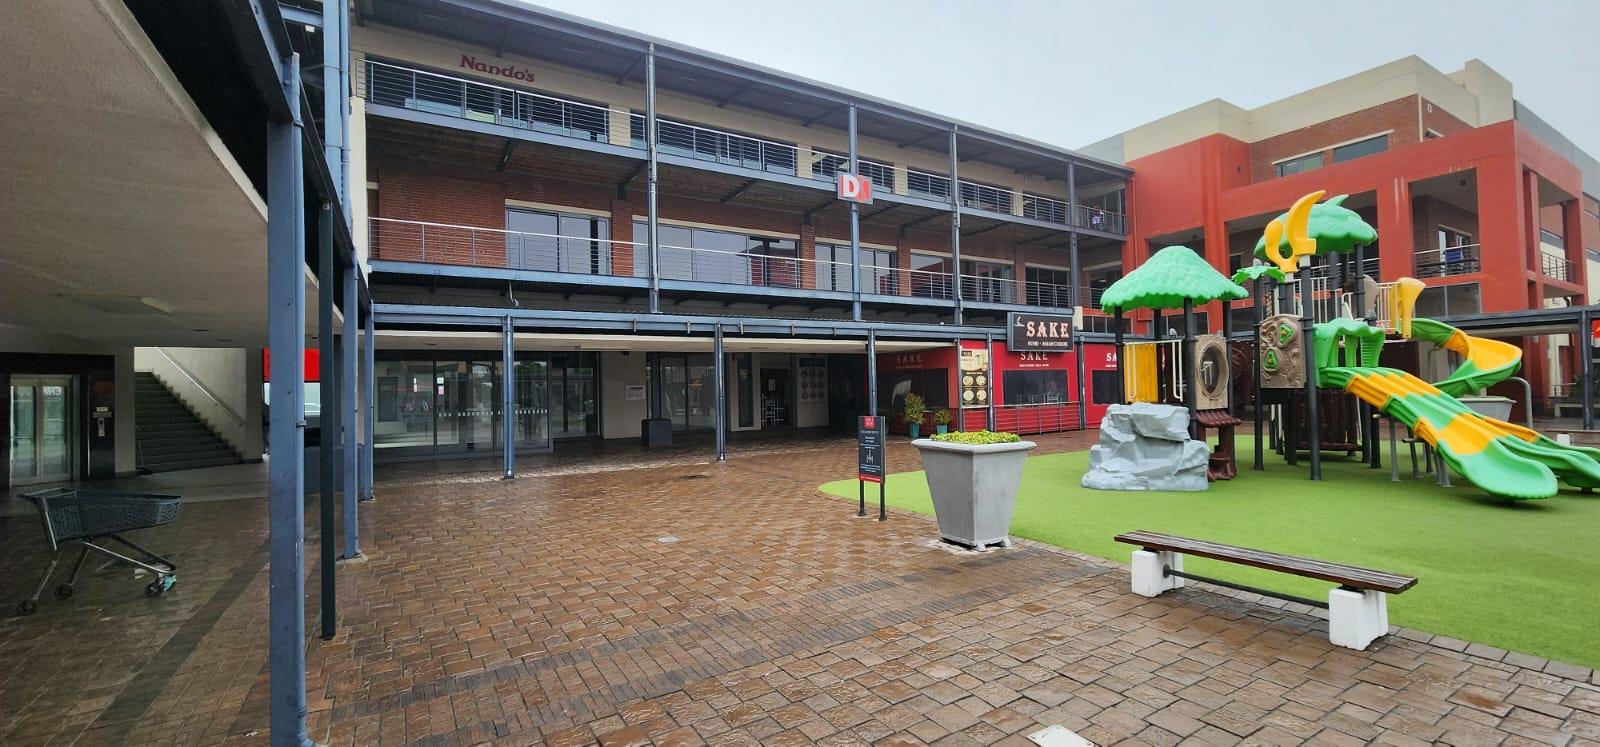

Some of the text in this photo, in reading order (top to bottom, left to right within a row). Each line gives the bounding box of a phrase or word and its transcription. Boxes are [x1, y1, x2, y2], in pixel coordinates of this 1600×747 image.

[460, 54, 535, 82] Nando's
[1026, 320, 1070, 338] SAKE
[1106, 352, 1117, 362] SA
